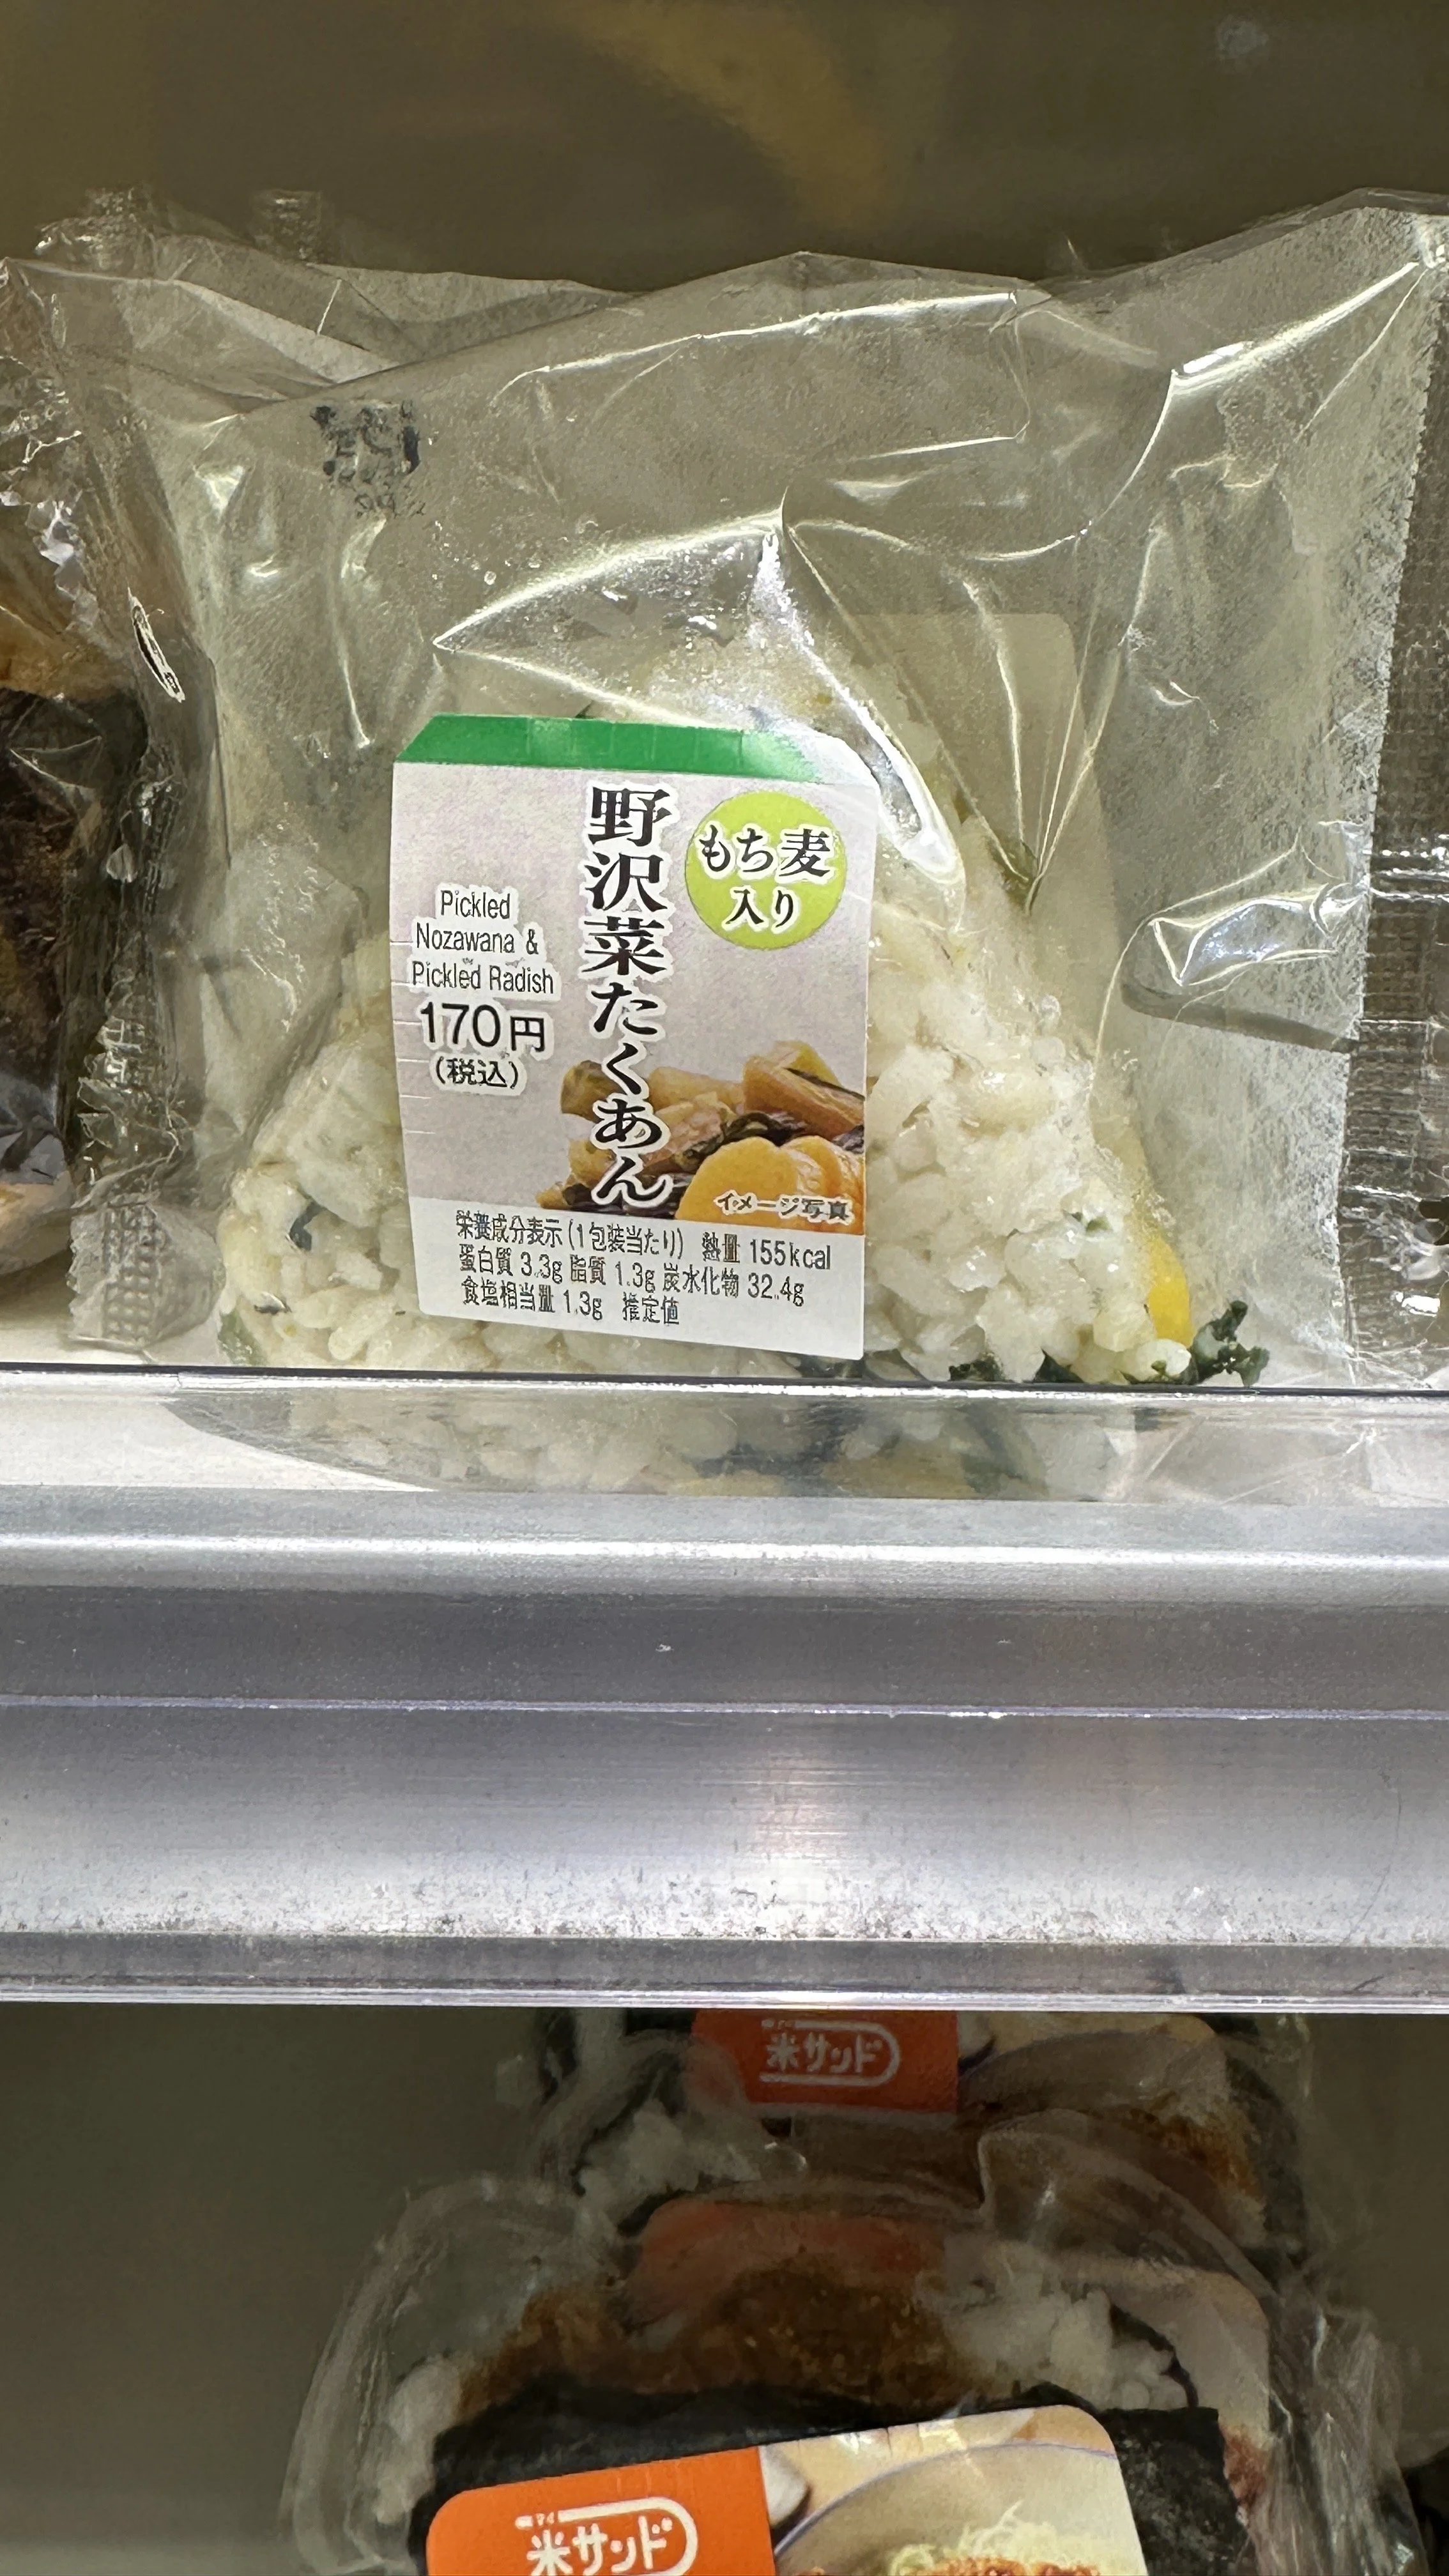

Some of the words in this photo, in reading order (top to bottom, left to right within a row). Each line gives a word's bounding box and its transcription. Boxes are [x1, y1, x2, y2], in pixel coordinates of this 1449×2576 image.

[700, 826, 831, 878] もち麦
[440, 890, 510, 919] Pickled
[724, 888, 796, 928] 入り
[417, 923, 515, 953] Nozawana
[526, 929, 539, 954] &
[412, 960, 481, 990] Pickled
[489, 965, 554, 994] Radish
[582, 785, 673, 1203] 野沢菜たくあん
[420, 1001, 546, 1052] 170円
[436, 1055, 519, 1090] (税込)
[717, 1193, 854, 1220] イメージ写真
[766, 2032, 884, 2073] 米サンド
[526, 2515, 673, 2575] 米サンド
